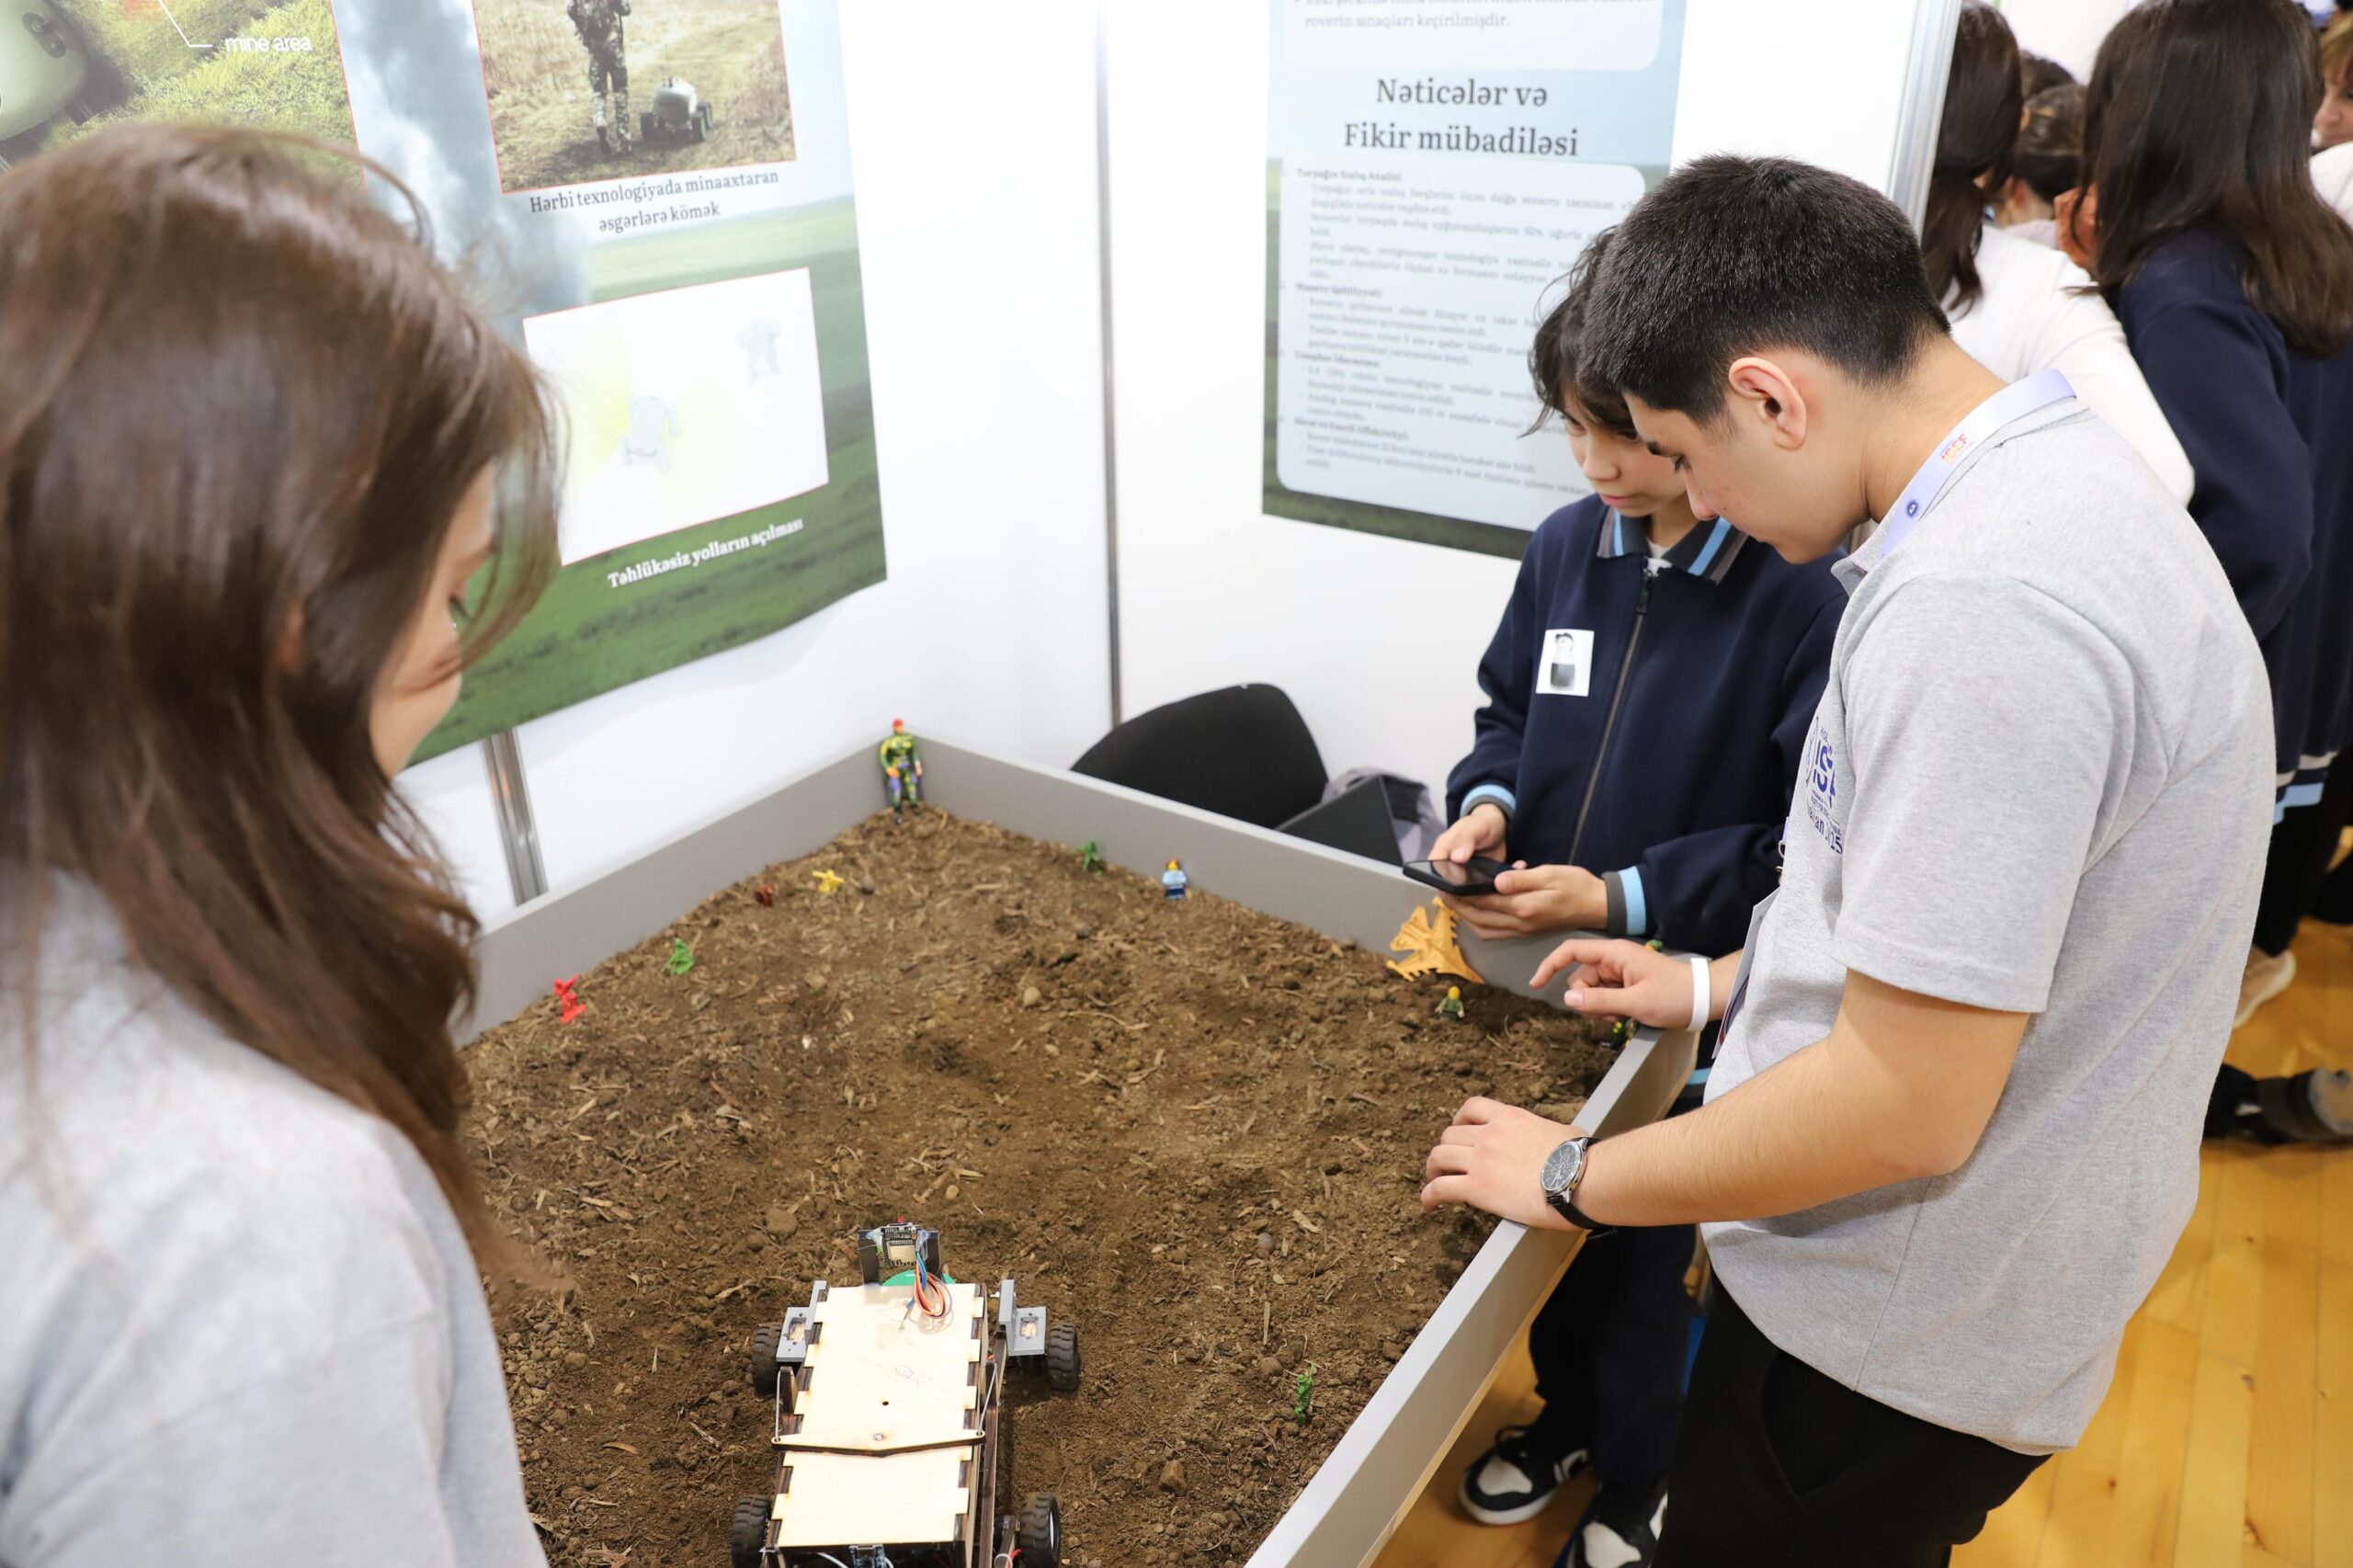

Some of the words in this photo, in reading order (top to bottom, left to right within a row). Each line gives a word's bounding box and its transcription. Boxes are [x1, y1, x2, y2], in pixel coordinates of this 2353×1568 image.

[224, 37, 269, 52] mine
[273, 37, 313, 52] area
[1376, 77, 1508, 107] Nəticələr
[1515, 85, 1548, 108] və
[1344, 121, 1412, 149] Fikir
[1418, 124, 1579, 157] mübadiləsi
[529, 189, 574, 213] Hərbi
[577, 179, 683, 207] texnologiyada
[686, 169, 779, 193] minaaxtaran
[599, 210, 668, 234] əsgərlərə
[671, 200, 721, 222] kömək
[608, 551, 692, 588] Təhlükəsiz
[691, 535, 750, 567] yolların
[751, 517, 804, 547] açılması
